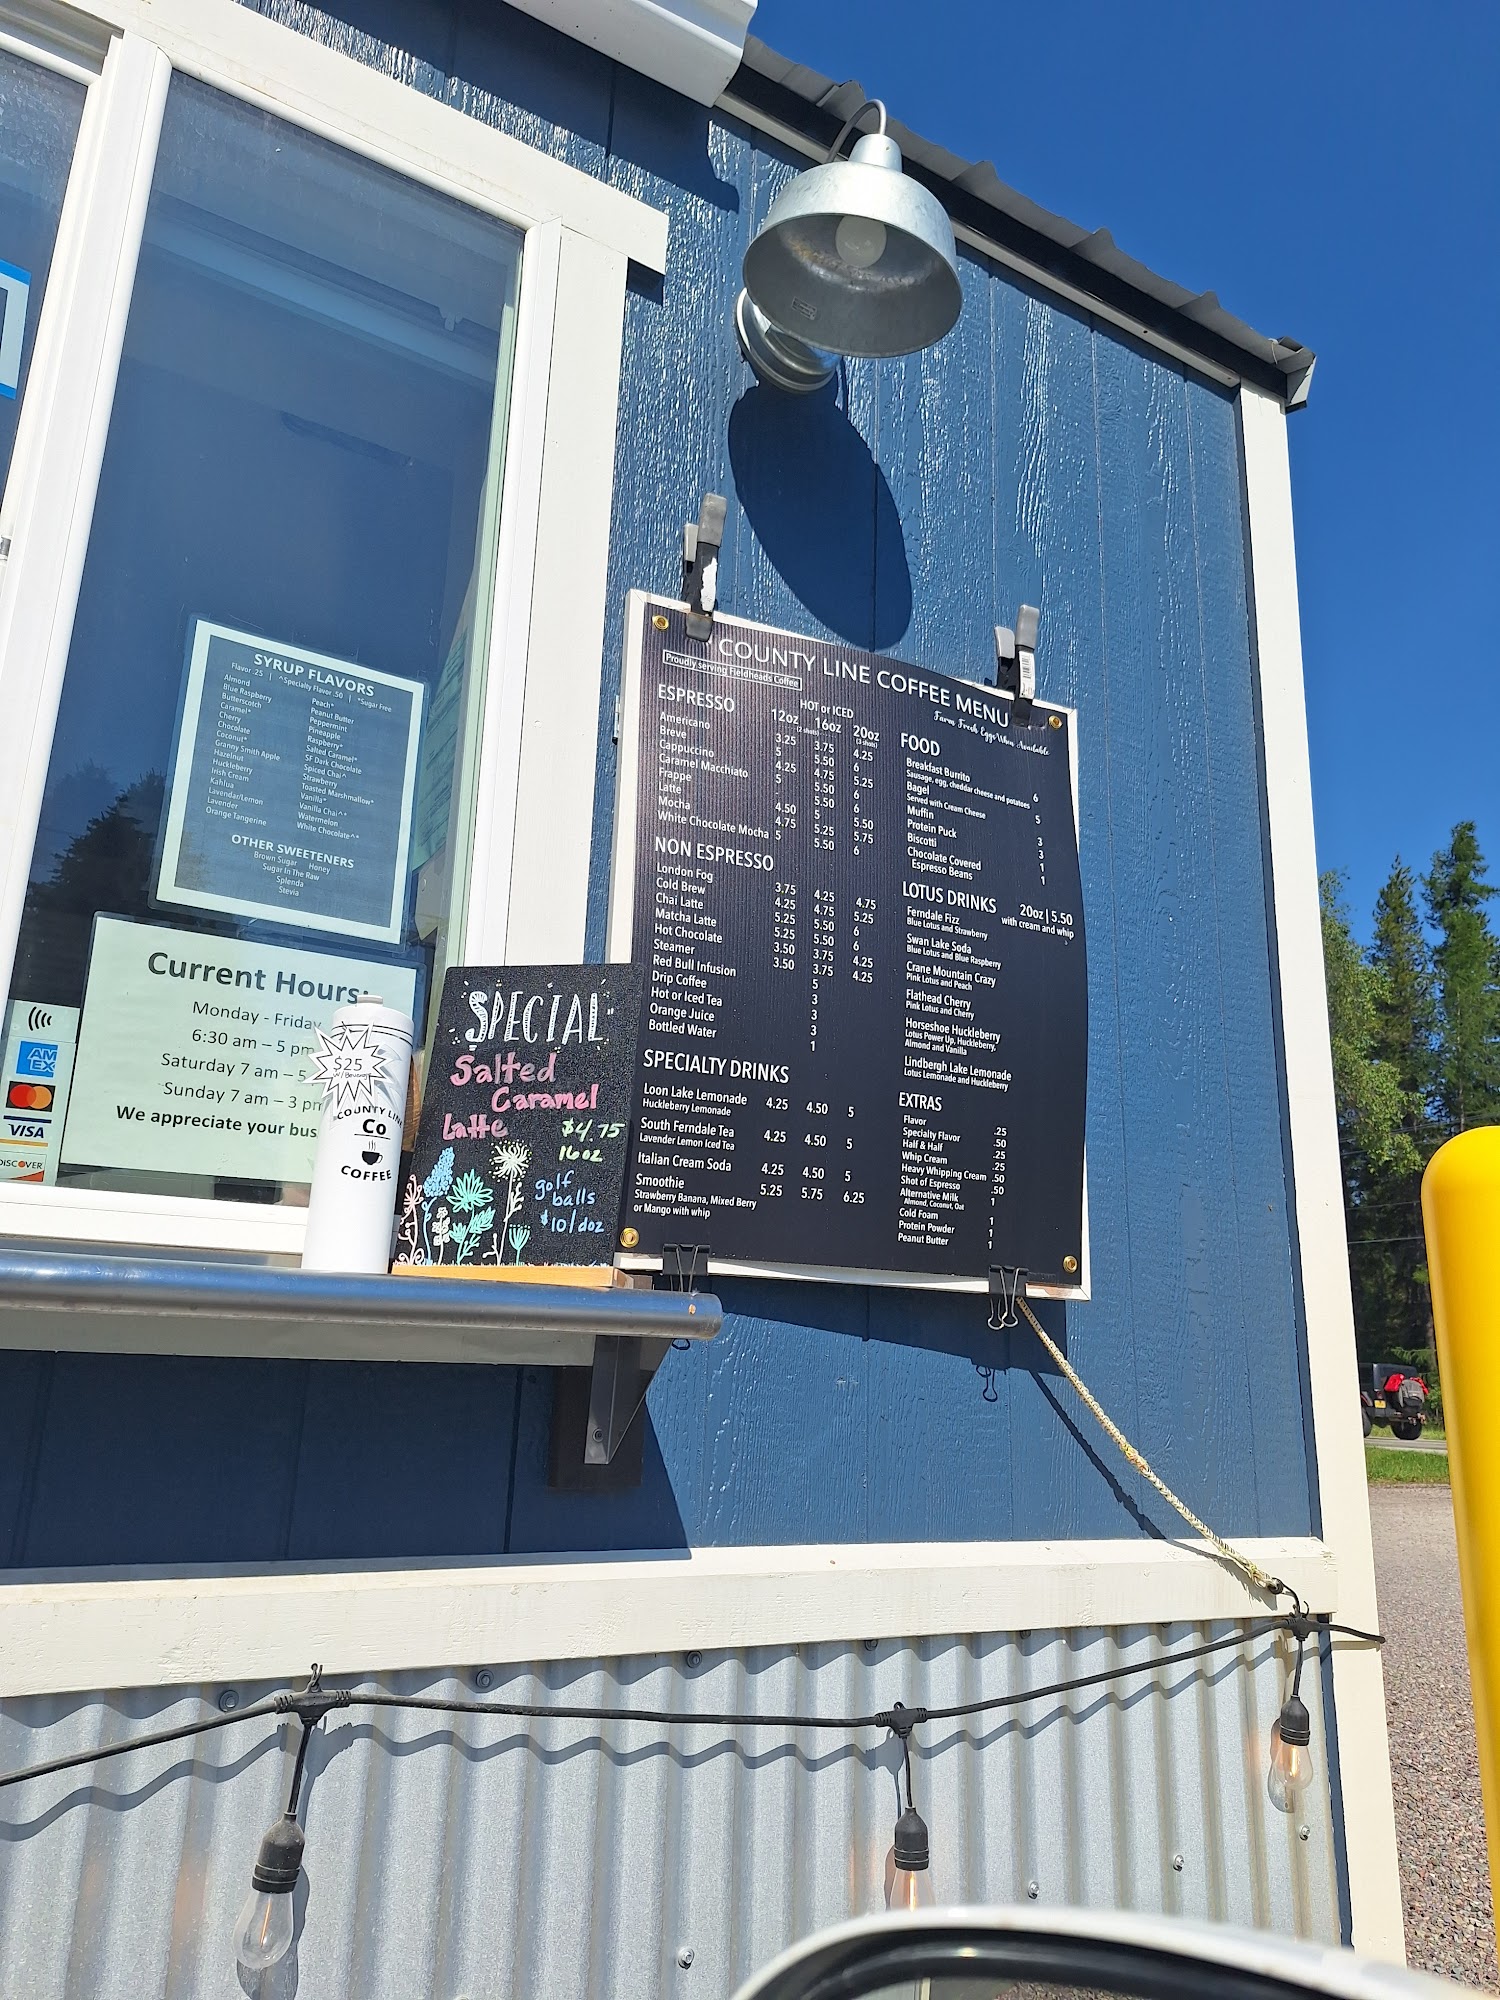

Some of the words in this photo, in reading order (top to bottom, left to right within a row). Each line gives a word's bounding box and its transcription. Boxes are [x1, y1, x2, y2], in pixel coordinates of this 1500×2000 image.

[254, 653, 304, 676] SYRUP
[308, 668, 375, 697] FLAVORS
[665, 654, 696, 670] Proudly
[698, 662, 727, 676] serving
[729, 667, 772, 683] Fieldheads
[774, 675, 799, 688] Coffee
[719, 638, 816, 672] COUNTY
[823, 658, 871, 684] LINE
[876, 670, 951, 707] COFFEE
[956, 694, 1009, 728] MENU
[222, 692, 262, 708] Butterscotch
[223, 683, 238, 693] Blue
[239, 687, 272, 704] Raspberry
[658, 683, 735, 713] ESPRESSO
[219, 711, 241, 724] Cherry
[800, 701, 819, 712] HOT
[821, 705, 830, 714] or
[832, 706, 854, 719] ICED
[217, 720, 250, 734] Chocolate
[308, 726, 341, 741] Pineapple
[310, 716, 347, 733] Peppermint
[660, 711, 710, 730] Americano
[775, 733, 796, 746] 3.25
[814, 741, 835, 753] 3.75
[853, 748, 873, 762] 4.25
[771, 708, 799, 725] 12oz
[814, 717, 842, 733] 16oz
[853, 725, 880, 742] 20oz
[214, 748, 244, 762] Hazelnut
[215, 739, 239, 753] Granny
[240, 745, 260, 756] Smith
[261, 751, 280, 761] Apple
[900, 732, 940, 757] FOOD
[212, 758, 253, 775] Huckleberry
[659, 739, 714, 758] Cappuccino
[775, 760, 797, 773] 4.25
[814, 768, 835, 781] 4.75
[853, 776, 873, 789] 5.25
[659, 753, 698, 769] Caramel
[701, 760, 748, 778] Macchiato
[775, 774, 782, 784] 5
[814, 782, 835, 795] 5.50
[853, 789, 860, 800] 6
[302, 773, 338, 790] Strawberry
[906, 757, 943, 775] Breakfast
[944, 767, 971, 783] Burrito
[1033, 793, 1039, 803] 6
[298, 811, 339, 827] Watermelon
[231, 834, 274, 851] OTHER
[276, 844, 355, 869] SWEETENERS
[254, 851, 276, 862] Brown
[277, 856, 297, 867] Sugar
[308, 862, 331, 875] Honey
[654, 836, 692, 858] NON
[696, 843, 774, 872] ESPRESSO
[276, 876, 304, 888] Splenda
[278, 886, 299, 897] Stevia
[656, 862, 693, 879] London
[696, 869, 714, 883] Fog
[774, 882, 796, 895] 3.75
[813, 889, 835, 903] 4.25
[855, 897, 877, 910] 4.75
[902, 880, 944, 904] LOTUS
[947, 890, 997, 914] DRINKS
[907, 906, 943, 922] Ferndale
[944, 913, 960, 925] Fizz
[1001, 916, 1017, 927] with
[1018, 921, 1040, 932] cream
[1042, 923, 1055, 935] and
[1056, 927, 1074, 940] whip
[655, 908, 692, 923] Matcha
[693, 913, 717, 927] Latte
[773, 927, 795, 940] 5.25
[812, 933, 834, 947] 5.50
[853, 942, 859, 951] 6
[147, 951, 266, 992] Current
[652, 954, 673, 968] Red
[675, 958, 694, 971] Bull
[697, 961, 736, 977] Infusion
[812, 978, 818, 990] 5
[906, 960, 931, 975] Crane
[932, 966, 973, 982] Mountain
[974, 973, 996, 989] Crazy
[192, 1001, 259, 1025] Monday
[274, 1013, 322, 1031] Friday
[465, 990, 603, 1045] SPECIAL
[29, 1048, 57, 1061] AM
[192, 1029, 228, 1046] 6:30
[232, 1036, 257, 1049] am
[276, 1040, 285, 1053] 5
[290, 1044, 315, 1058] pm
[31, 1060, 56, 1072] EX
[161, 1052, 235, 1077] Saturday
[240, 1062, 249, 1076] 7
[254, 1067, 279, 1079] am
[297, 1069, 307, 1083] 5
[333, 1056, 362, 1072] $25
[450, 1052, 557, 1086] Salted
[642, 1049, 727, 1076] SPECIALTY
[729, 1059, 790, 1084] DRINKS
[163, 1081, 225, 1104] Sunday
[231, 1090, 240, 1102] 7
[243, 1094, 269, 1106] am
[287, 1096, 298, 1109] 3
[491, 1084, 599, 1113] Caramel
[643, 1082, 669, 1097] Loon
[671, 1085, 694, 1099] Lake
[696, 1088, 748, 1105] Lemonade
[766, 1097, 789, 1110] 4.25
[805, 1102, 829, 1114] 4.50
[848, 1106, 855, 1118] 5
[898, 1092, 943, 1112] EXTRAS
[116, 1104, 145, 1121] We
[150, 1110, 242, 1132] appreciate
[247, 1120, 285, 1136] your
[337, 1105, 386, 1120] COUNTY
[8, 1124, 45, 1138] VISA
[362, 1118, 387, 1135] Co
[442, 1113, 508, 1141] Latte
[561, 1117, 625, 1143] $4.75
[902, 1127, 937, 1141] Specialty
[938, 1131, 960, 1143] Flavor
[993, 1139, 1007, 1148] .50
[341, 1165, 392, 1181] COFFEE
[637, 1152, 670, 1166] Italian
[672, 1154, 705, 1169] Cream
[707, 1159, 732, 1172] Soda
[761, 1162, 784, 1176] 4.25
[802, 1167, 825, 1180] 4.50
[844, 1171, 851, 1182] 5
[535, 1170, 574, 1200] golf
[552, 1188, 596, 1206] balls
[540, 1209, 605, 1234] $10/doz
[633, 1204, 643, 1212] or
[643, 1203, 672, 1217] Mango
[672, 1206, 690, 1216] with
[690, 1208, 711, 1220] whip
[898, 1233, 924, 1244] Peanut
[926, 1235, 949, 1246] Butter
[988, 1241, 993, 1250] 1
